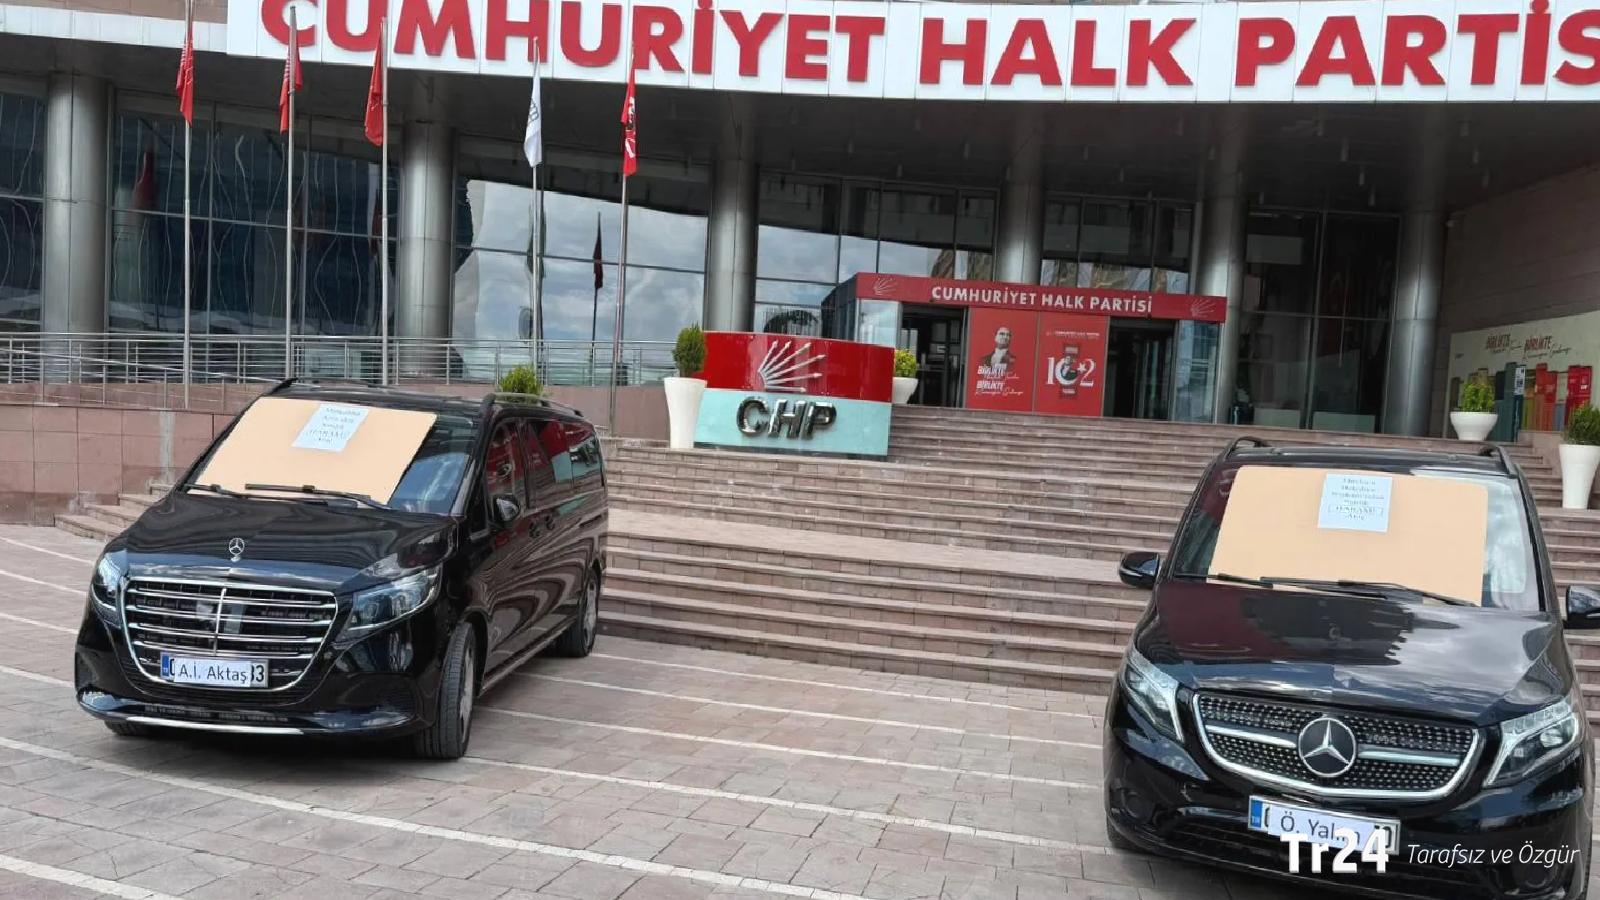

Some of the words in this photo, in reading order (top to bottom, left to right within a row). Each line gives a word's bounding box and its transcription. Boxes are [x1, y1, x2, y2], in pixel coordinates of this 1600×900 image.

[261, 0, 885, 83] CUMHURİYET
[919, 17, 1198, 87] HALK
[931, 286, 1035, 305] CUMHURİYET
[1041, 293, 1085, 310] HALK
[1089, 296, 1152, 313] PARTİSİ
[736, 395, 837, 441] CHP
[207, 664, 247, 683] Aktaş
[1280, 810, 1300, 834] Ö.
